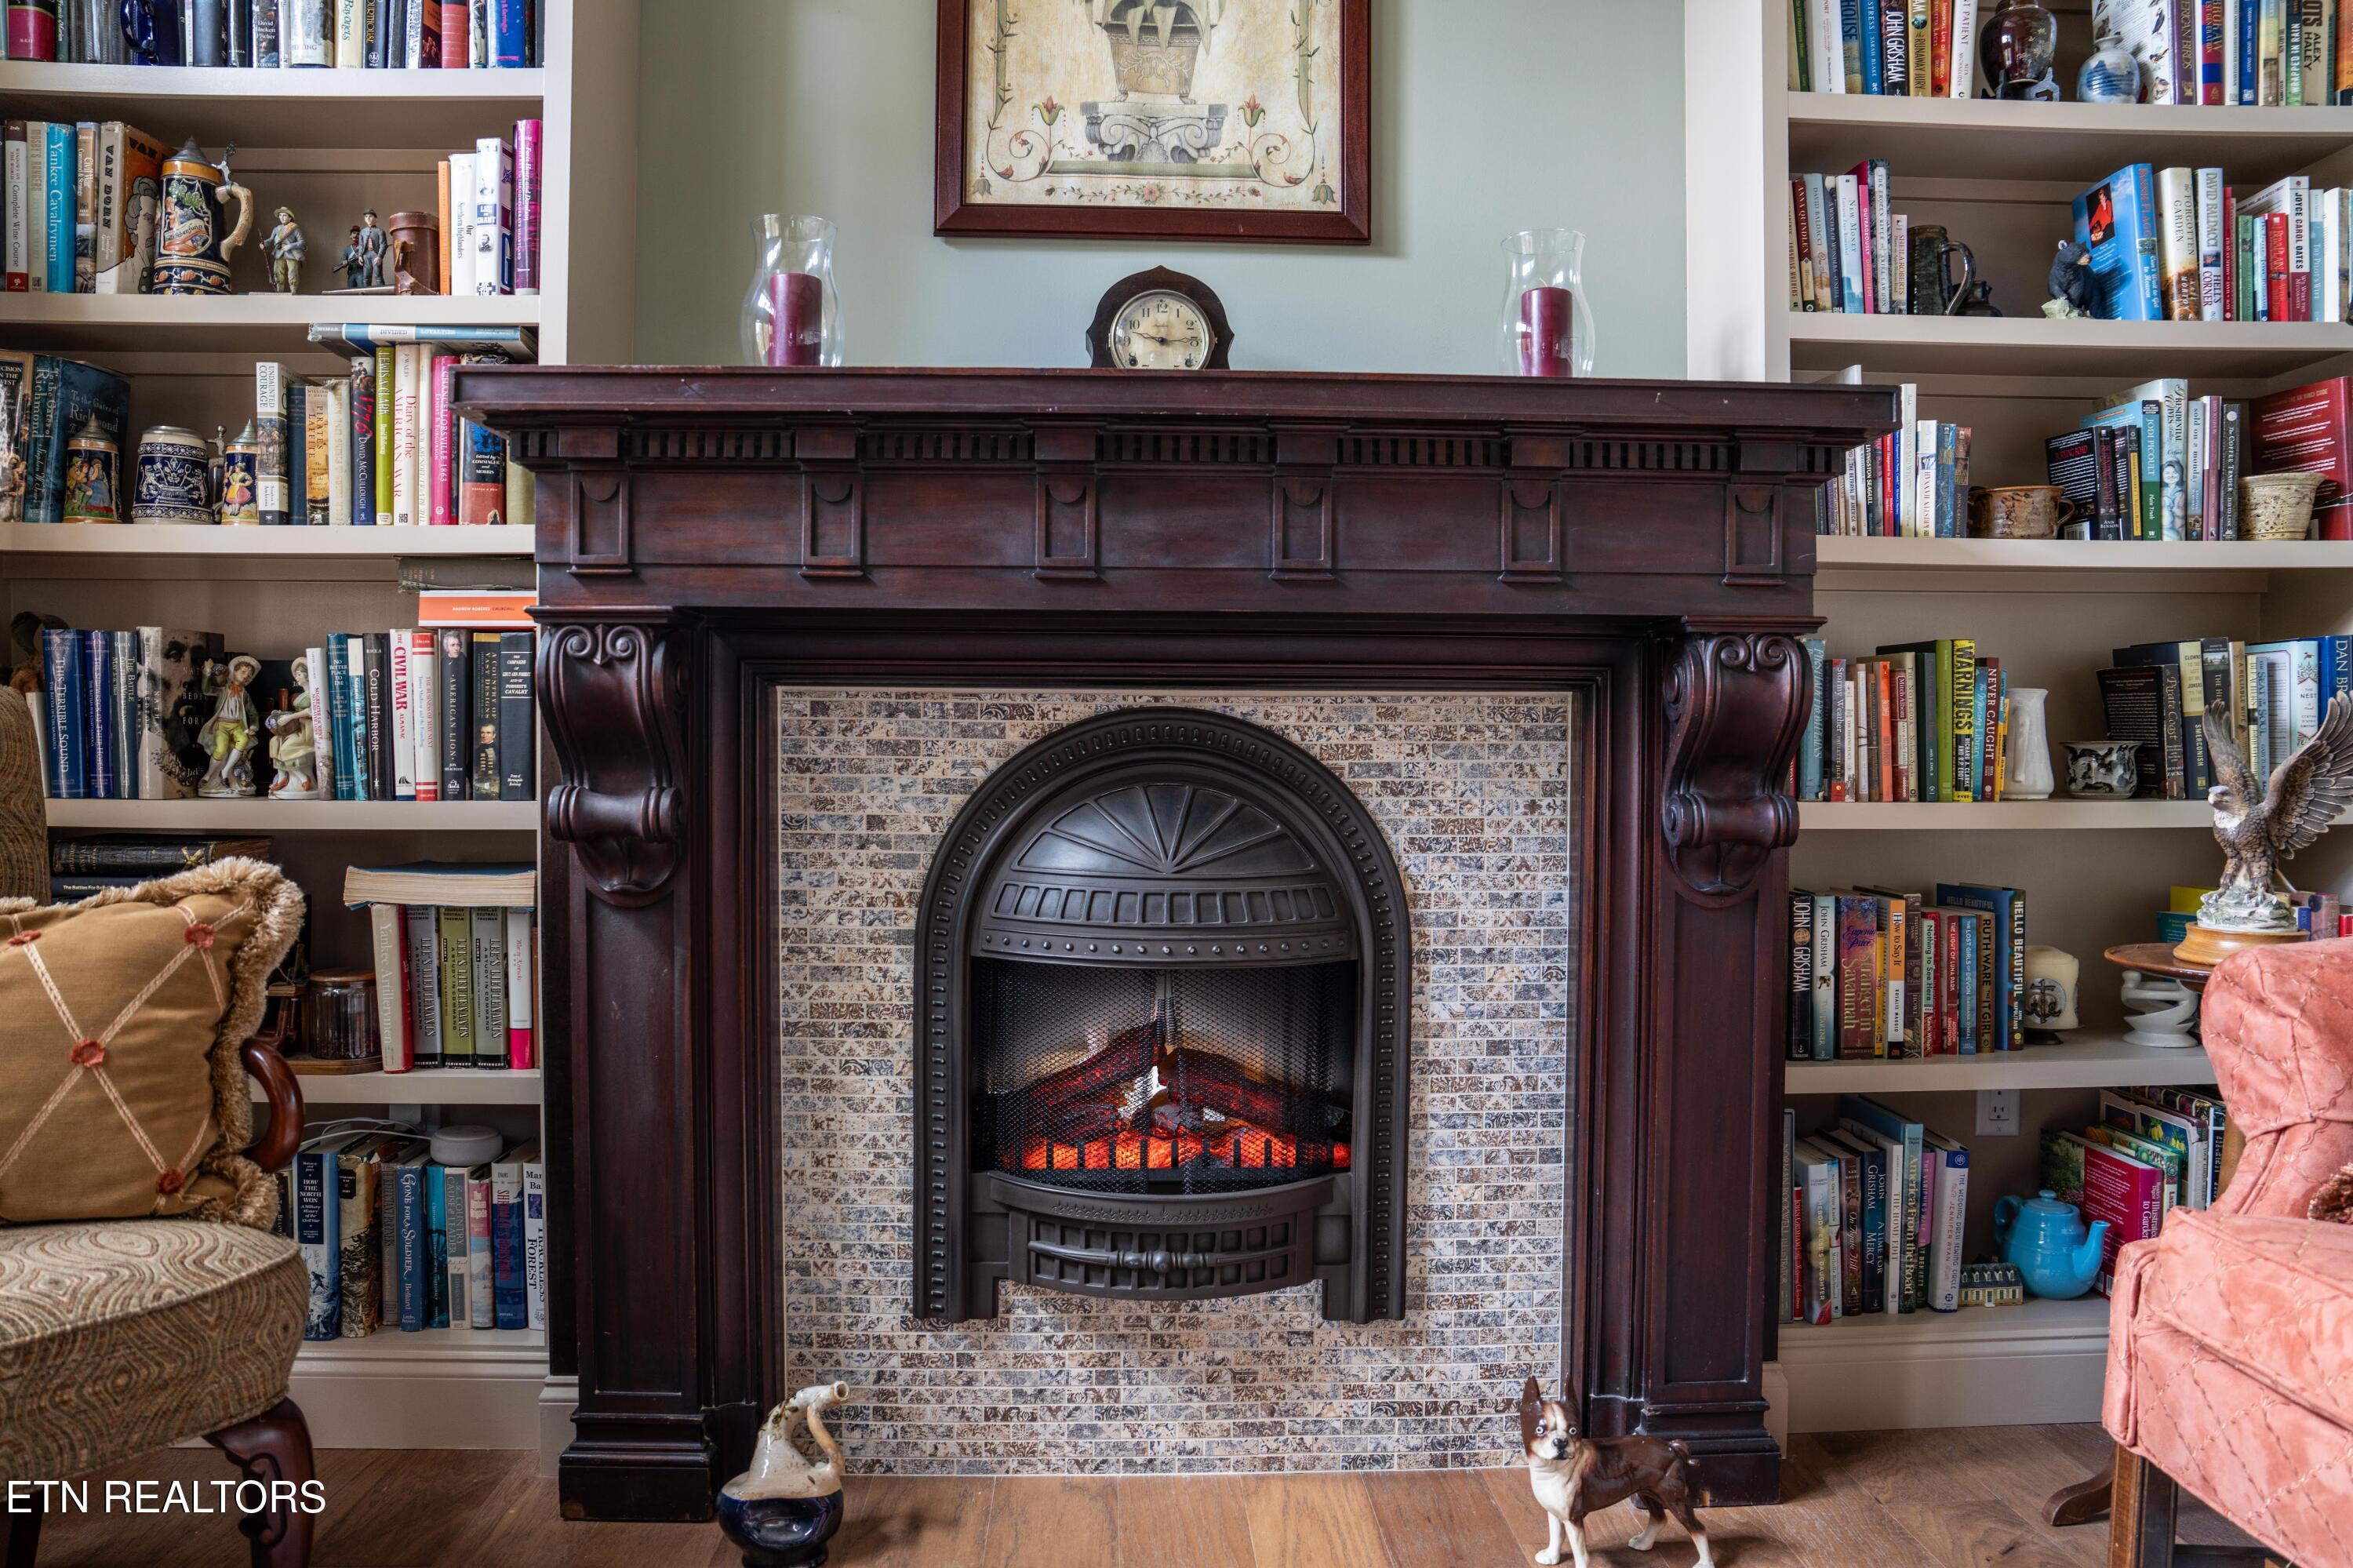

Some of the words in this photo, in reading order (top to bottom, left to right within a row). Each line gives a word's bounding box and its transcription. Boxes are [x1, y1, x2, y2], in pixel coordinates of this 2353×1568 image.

[341, 0, 354, 40] Bayonets
[1886, 11, 1904, 36] JOHN
[1961, 11, 1970, 45] PATIENT
[2290, 24, 2301, 42] RAIN
[1887, 38, 1905, 83] GRISHAM
[2182, 40, 2192, 70] BIRDS
[2290, 45, 2300, 54] IN
[2304, 31, 2312, 71] HALEY
[2290, 56, 2301, 93] WRAPPED
[50, 141, 63, 186] Yankee
[84, 157, 93, 173] Civil
[105, 144, 115, 177] VAN
[84, 173, 93, 188] War
[2138, 167, 2151, 202] FANNIE
[2205, 173, 2217, 201] DAVID
[11, 184, 20, 220] Complete
[103, 184, 111, 229] DORN
[1797, 186, 1806, 209] ANNA
[2294, 192, 2303, 217] JOYCE
[48, 189, 63, 261] Cavalrymen
[1799, 211, 1809, 254] QUINDLEN
[2140, 203, 2153, 238] FLAGG
[2173, 200, 2184, 242] GARDEN
[2184, 195, 2195, 256] FORGOTTEN
[2206, 203, 2219, 248] BALDACCI
[2202, 271, 2213, 307] CORNER
[2213, 275, 2221, 304] HELL'S
[1142, 307, 1150, 318] 11
[1157, 303, 1168, 313] 12
[1129, 319, 1140, 330] 10
[1186, 319, 1194, 330] 2
[47, 382, 56, 397] the
[49, 369, 59, 380] To
[31, 367, 49, 438] Richmond
[45, 400, 56, 428] Gates
[351, 396, 373, 436] 1776
[404, 395, 416, 424] Diary
[44, 431, 53, 439] of
[394, 387, 403, 461] AMERICAN
[405, 429, 416, 439] of
[2146, 418, 2155, 439] JODI
[2193, 430, 2199, 439] on
[405, 442, 416, 458] the
[394, 467, 403, 498] WAR
[2191, 451, 2200, 483] monday
[56, 657, 66, 682] THIS
[395, 646, 406, 679] CIVIL
[2335, 640, 2348, 672] DAN
[369, 668, 379, 700] COLD
[395, 680, 408, 711] WAR
[1955, 646, 1974, 730] WARNINGS
[1987, 668, 1997, 706] NEVER
[2166, 677, 2178, 710] Pirate
[2258, 671, 2268, 695] SEAT
[56, 685, 67, 731] TERRIBLE
[492, 707, 496, 719] OF
[2259, 709, 2268, 737] SOUL
[370, 704, 380, 751] HARBOR
[1985, 710, 1995, 760] CAUGHT
[2168, 711, 2179, 740] Coast
[60, 734, 69, 773] SOUND
[2195, 724, 2204, 766] SMERCONISH
[1793, 901, 1809, 928] JOHN
[1819, 905, 1830, 928] JOHN
[2014, 901, 2024, 933] HELLO
[379, 922, 393, 966] Yankee
[420, 937, 434, 965] LEE'S
[1820, 930, 1830, 967] GRISHAM
[1924, 925, 1933, 951] Nothing
[1982, 919, 1991, 951] RUTH
[456, 938, 467, 966] LEE'S
[489, 938, 500, 966] LEE'S
[1926, 954, 1933, 962] to
[2013, 938, 2024, 997] BEAUTIFUL
[452, 980, 456, 988] IN
[485, 980, 489, 989] IN
[1793, 947, 1810, 991] GRISHAM
[1860, 954, 1874, 1006] Stranger
[1981, 953, 1991, 986] WARE
[380, 968, 393, 1043] Artillerymen
[422, 969, 436, 1037] LIEUTENANTS
[458, 970, 469, 1038] LIEUTENANTS
[491, 970, 502, 1039] LIEUTENANTS
[1842, 958, 1859, 1029] Savannah
[1860, 1010, 1875, 1031] in
[382, 1179, 396, 1215] RELUCTANT
[1867, 1165, 1878, 1210] GRISHAM
[1907, 1155, 1919, 1207] America
[383, 1216, 396, 1246] PARTNERS
[447, 1217, 456, 1253] LEADER
[455, 1196, 464, 1246] COUNTRY
[1906, 1209, 1917, 1241] From
[1947, 1201, 1955, 1239] JENNIFER
[527, 1238, 537, 1289] FOREST
[1865, 1231, 1876, 1265] MERCY
[1906, 1243, 1916, 1261] the
[1904, 1264, 1915, 1294] Road
